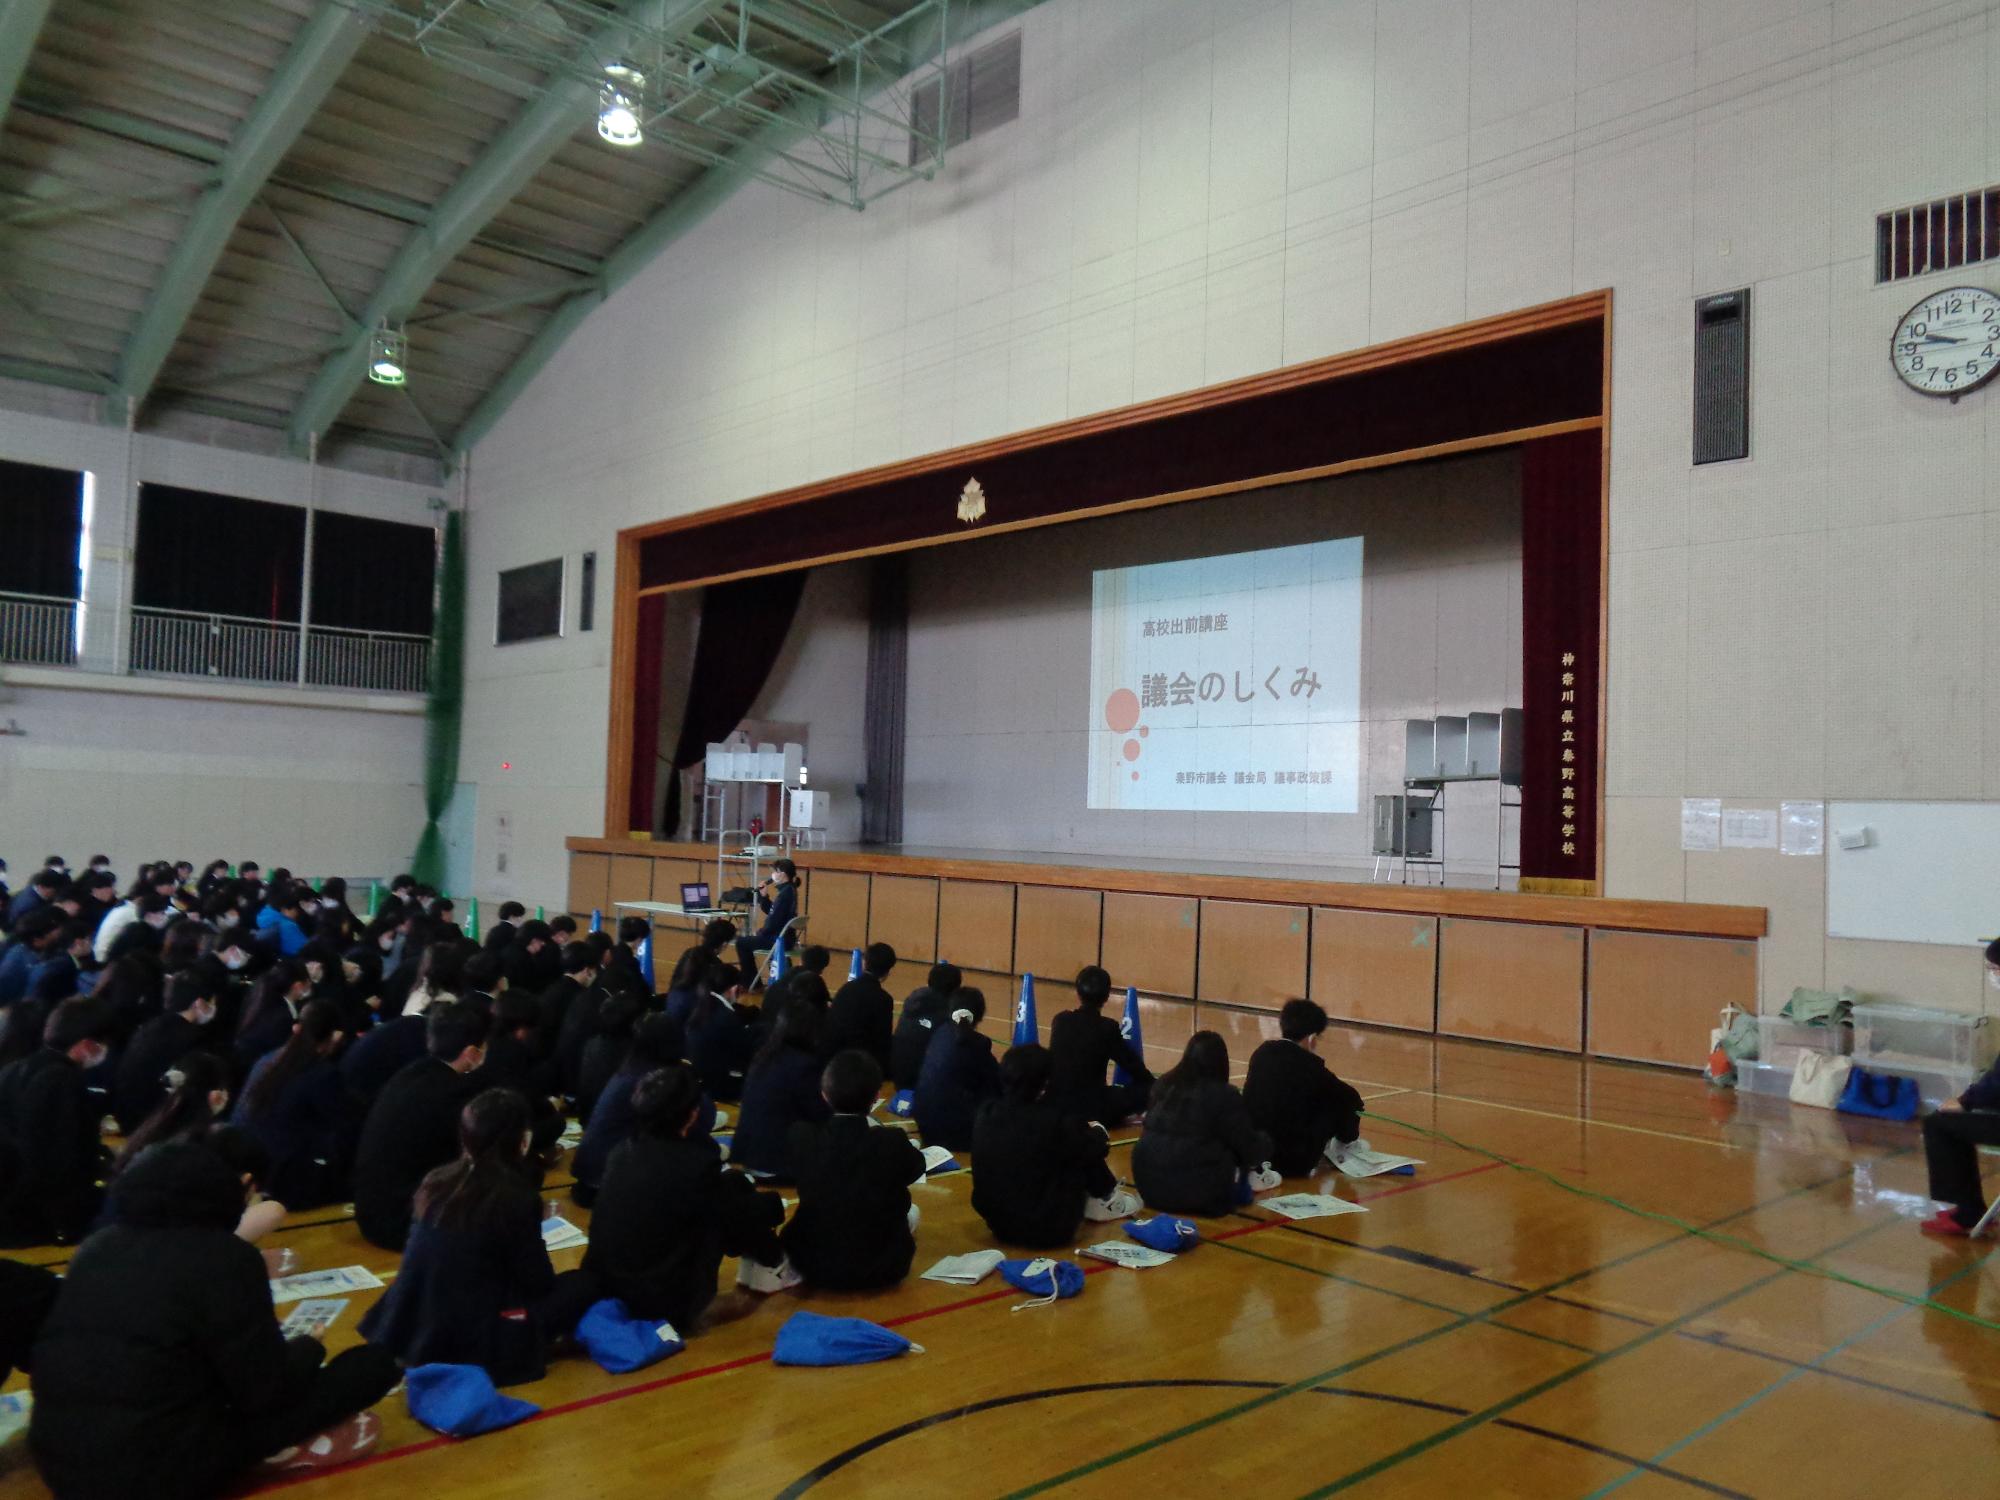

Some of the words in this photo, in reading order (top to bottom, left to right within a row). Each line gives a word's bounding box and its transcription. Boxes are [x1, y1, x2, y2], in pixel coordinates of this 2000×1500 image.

[1927, 307, 1940, 322] 11
[1945, 298, 1963, 315] 12
[1982, 308, 1995, 324] 2
[1910, 322, 1927, 339] 10
[1987, 325, 2000, 341] 3
[1904, 341, 1918, 357] 9
[1981, 343, 1994, 358] 4
[1911, 356, 1924, 371] 8
[1966, 360, 1979, 375] 5
[1928, 367, 1940, 382] 7
[1945, 367, 1958, 383] 6
[1142, 613, 1228, 638] 高校出前講座
[1141, 665, 1322, 709] 議会のしくみ
[1561, 652, 1576, 856] 神奈川県立秦野高等学校
[1016, 1001, 1027, 1022] 3
[1120, 1017, 1132, 1040] 2
